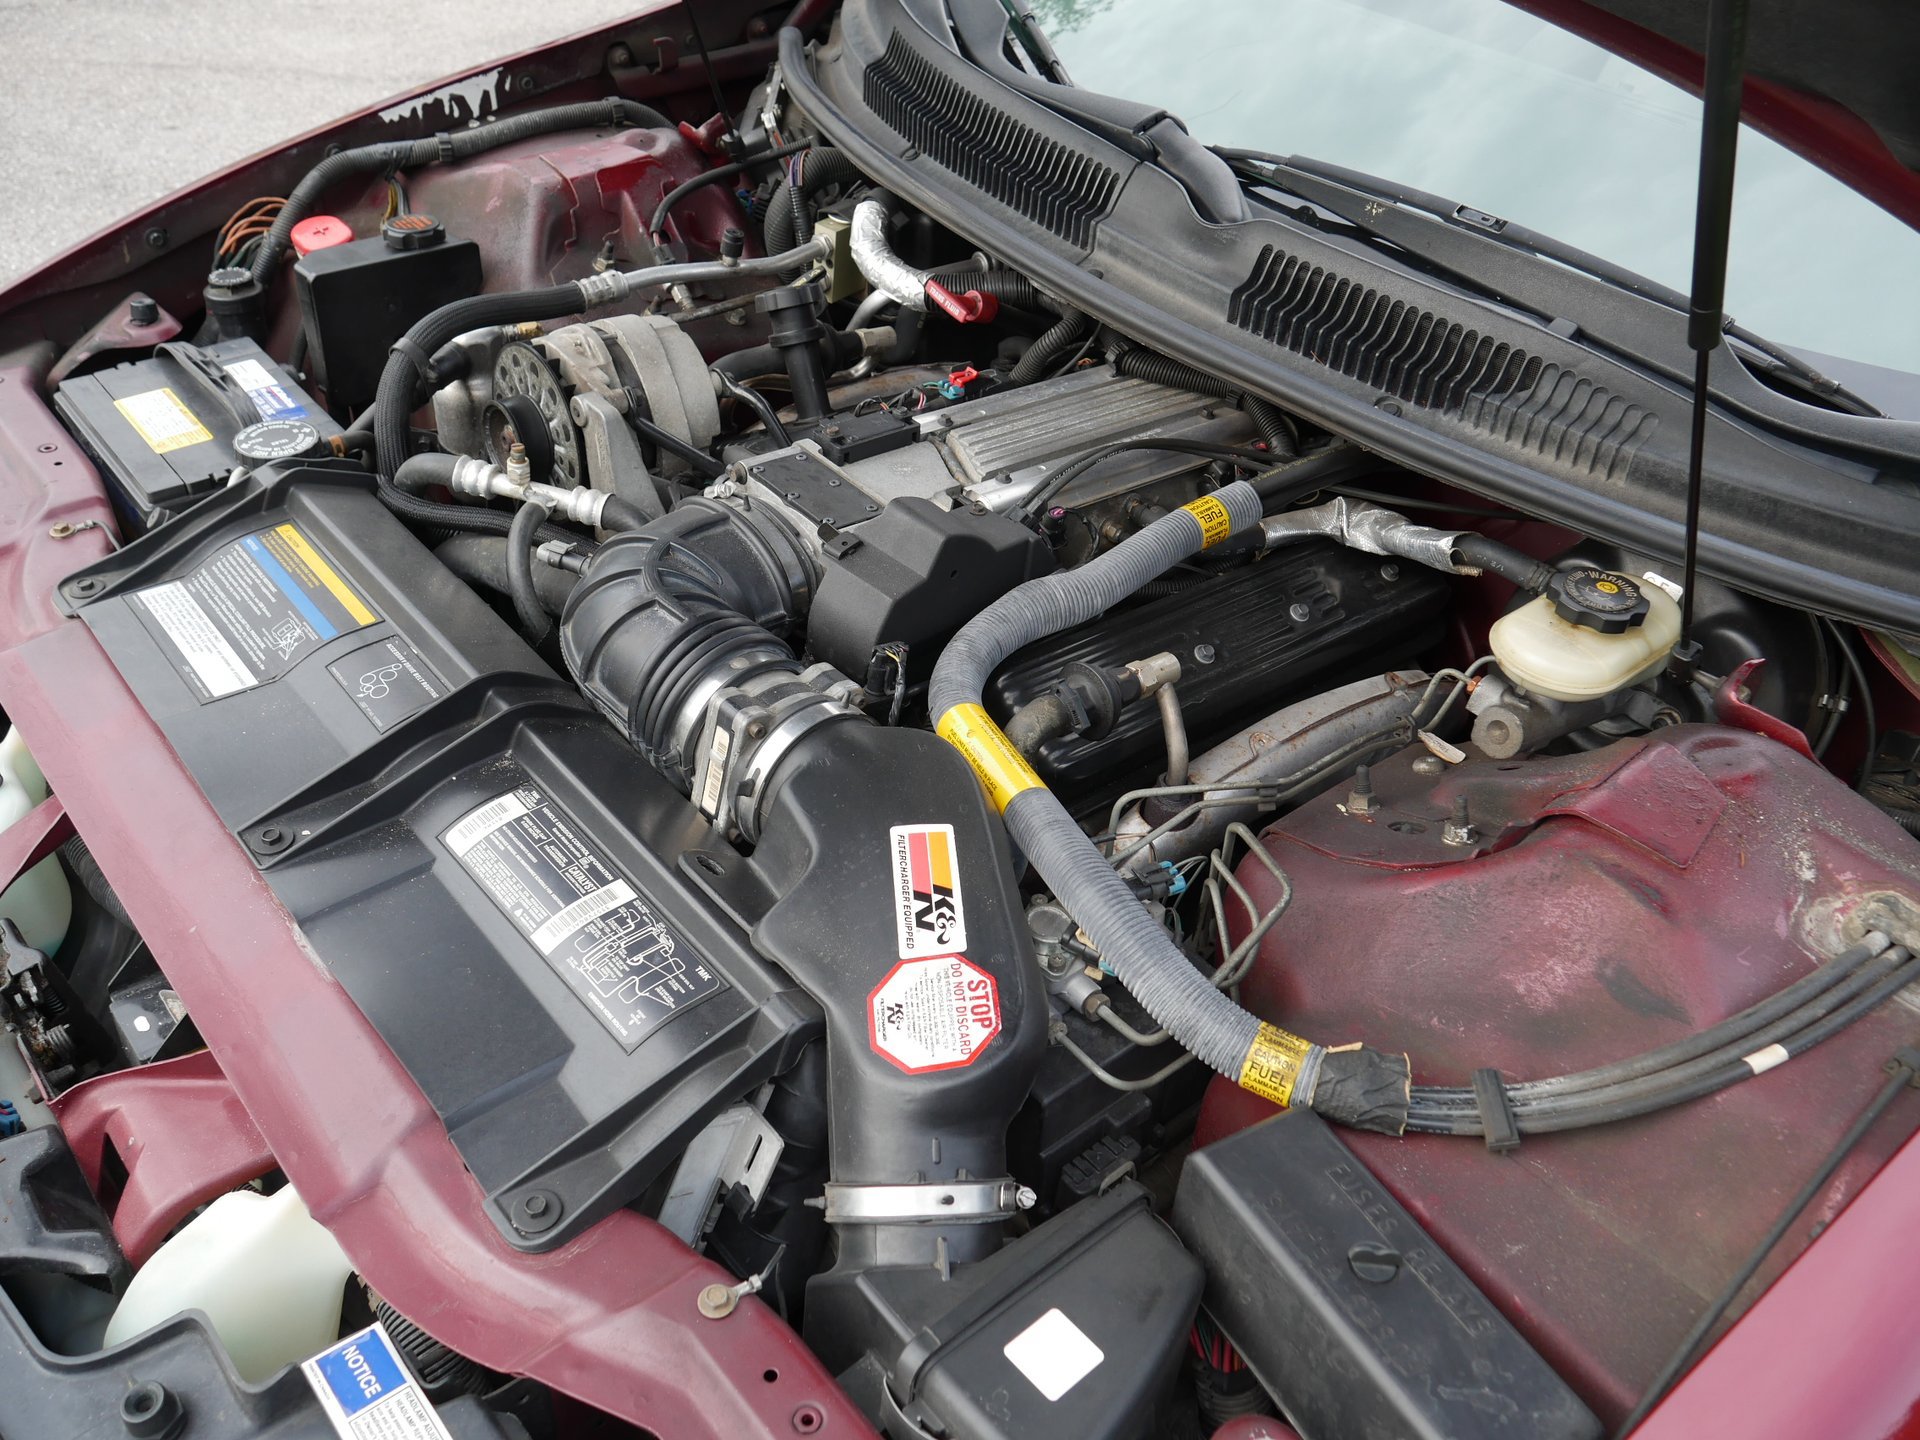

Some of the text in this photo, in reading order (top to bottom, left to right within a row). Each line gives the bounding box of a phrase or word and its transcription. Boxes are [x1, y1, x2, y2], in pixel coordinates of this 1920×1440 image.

[926, 286, 961, 315] TRANS FLUID
[1190, 499, 1214, 511] CAUTION
[1200, 508, 1224, 524] FUEL
[1204, 519, 1227, 533] CAUTION
[1588, 570, 1638, 598] WARNING
[386, 642, 438, 698] ACCESSORY DRIVE BELT ROUTING
[955, 737, 966, 749] LINES
[963, 747, 973, 759] MUST
[541, 806, 557, 822] VEHICLE
[555, 820, 573, 839] EMISSION
[570, 836, 590, 856] CONTROL
[586, 853, 614, 881] INFORMATION
[549, 844, 568, 863] AUTOMATIC
[567, 864, 597, 894] CATALYST
[897, 834, 914, 949] FILTERCHARGER EQUIPPED
[913, 883, 957, 945] K&N
[693, 965, 711, 981] TMK
[586, 991, 629, 1036] EMISSION HOSE ROUTING
[887, 1002, 904, 1031] K&N
[946, 1003, 956, 1030] EQUIPPED
[950, 963, 972, 1055] DO NOT DISCARD
[967, 979, 993, 1029] STOP
[880, 997, 888, 1041] FILTERCHARGER
[1254, 1048, 1296, 1072] CAUTION
[1244, 1073, 1286, 1095] FLAMMABLE
[1248, 1061, 1287, 1089] FUEL
[1242, 1081, 1284, 1103] CAUTION
[1325, 1163, 1398, 1235] FUSES
[341, 1344, 382, 1400] NOTICE
[396, 1398, 416, 1429] HEADLAMP
[404, 1390, 428, 1423] HEADLAMP
